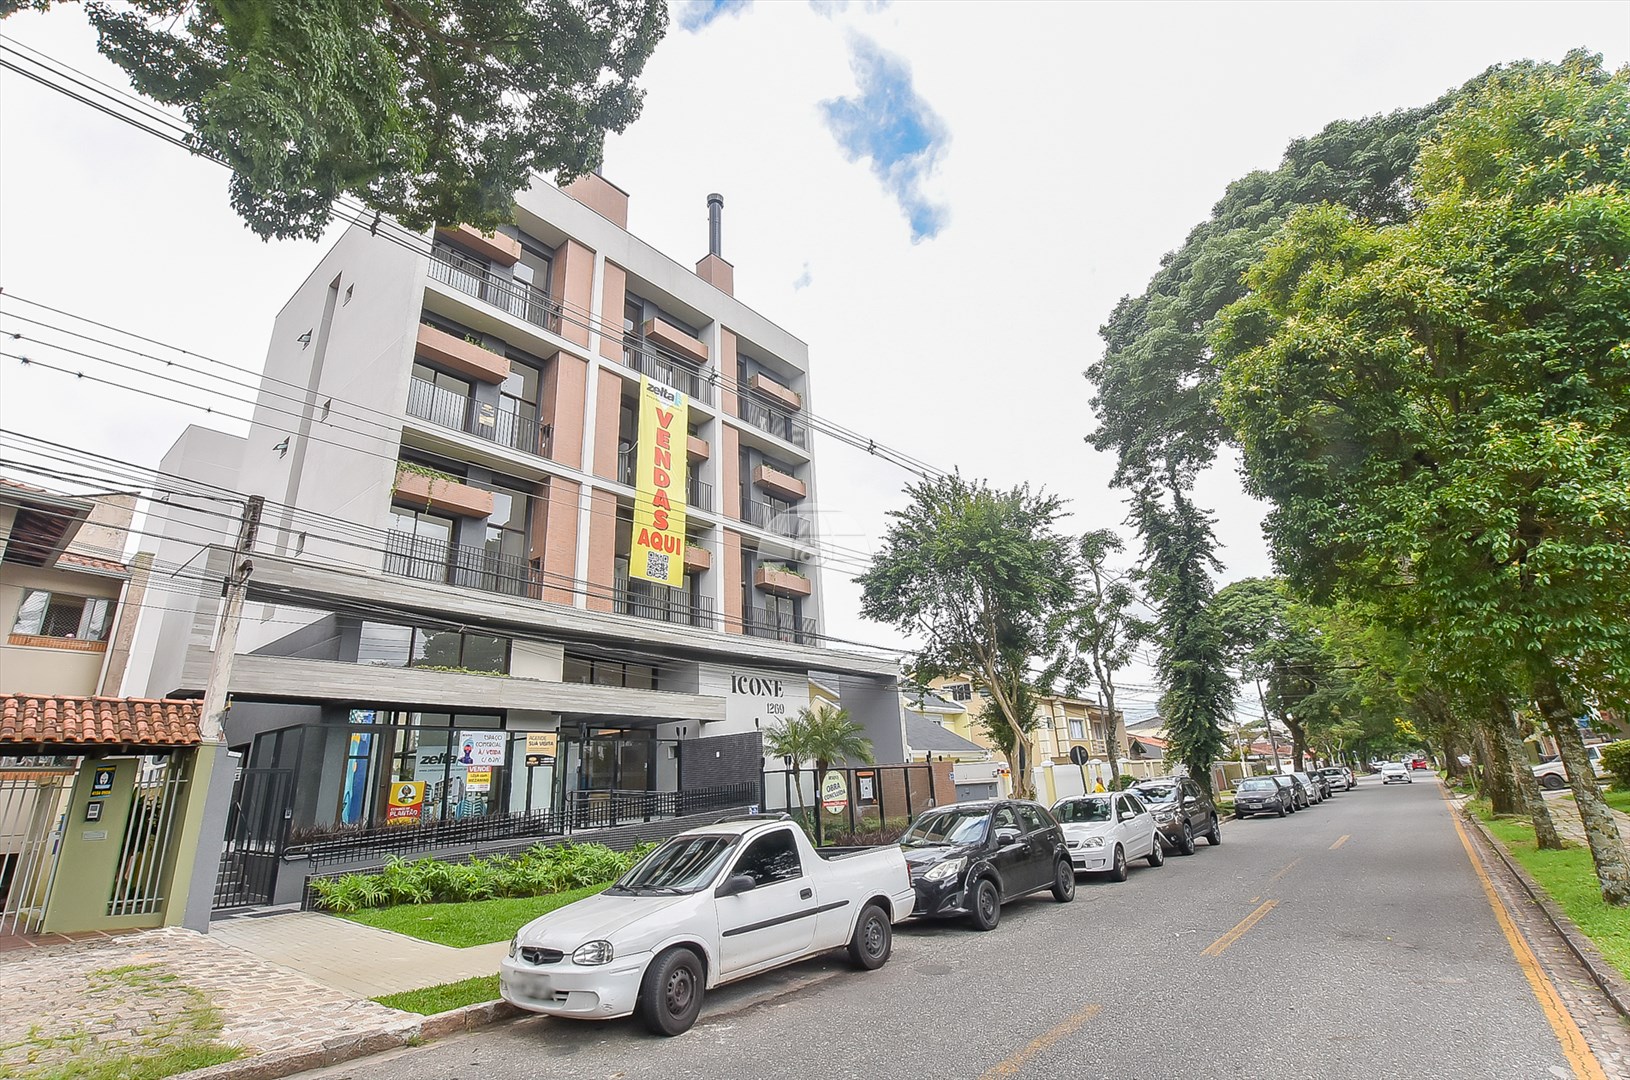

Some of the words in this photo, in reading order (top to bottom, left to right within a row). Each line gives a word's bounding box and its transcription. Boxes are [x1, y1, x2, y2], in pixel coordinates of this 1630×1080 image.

[647, 383, 675, 402] zelta
[653, 406, 673, 531] VENDAS
[637, 528, 681, 556] AQUI
[766, 702, 785, 715] 1269
[483, 734, 503, 742] ESPAÇO
[826, 782, 842, 793] OBRA
[389, 808, 418, 817] PLANTÃO
